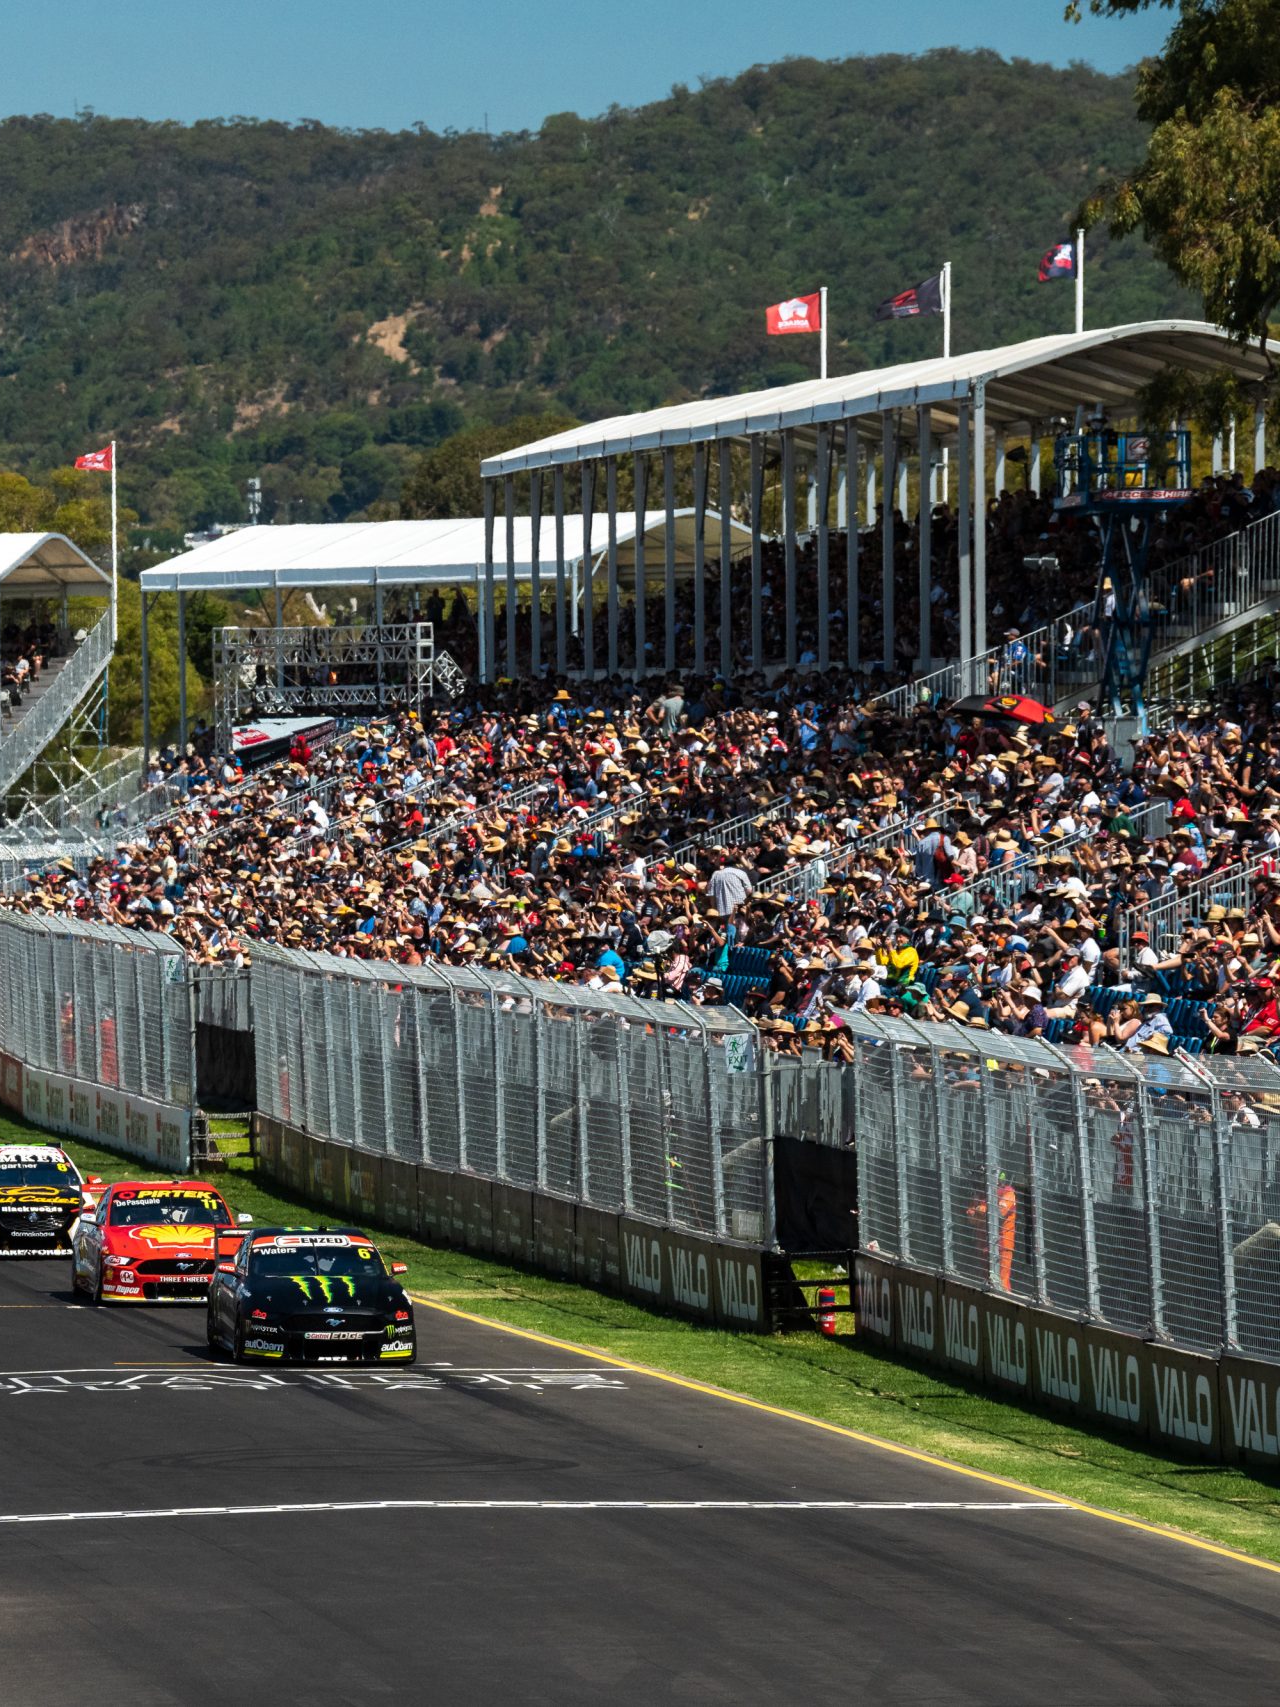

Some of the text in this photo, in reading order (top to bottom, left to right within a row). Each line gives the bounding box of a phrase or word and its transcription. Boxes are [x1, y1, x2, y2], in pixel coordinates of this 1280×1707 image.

[56, 1163, 68, 1172] 8
[137, 1190, 212, 1199] PIRTEK
[18, 1196, 80, 1204] Cadet
[116, 1198, 160, 1207] De Pasquale
[201, 1199, 218, 1210] 11
[260, 1247, 297, 1255] Waters
[357, 1248, 371, 1259] 6
[624, 1231, 758, 1322] VALO VALO VALO
[116, 1285, 140, 1295] Repco
[331, 1332, 364, 1340] EDGE
[857, 1268, 1280, 1455] VALO VALO VALO VALO VALO VALO VALO VAL
